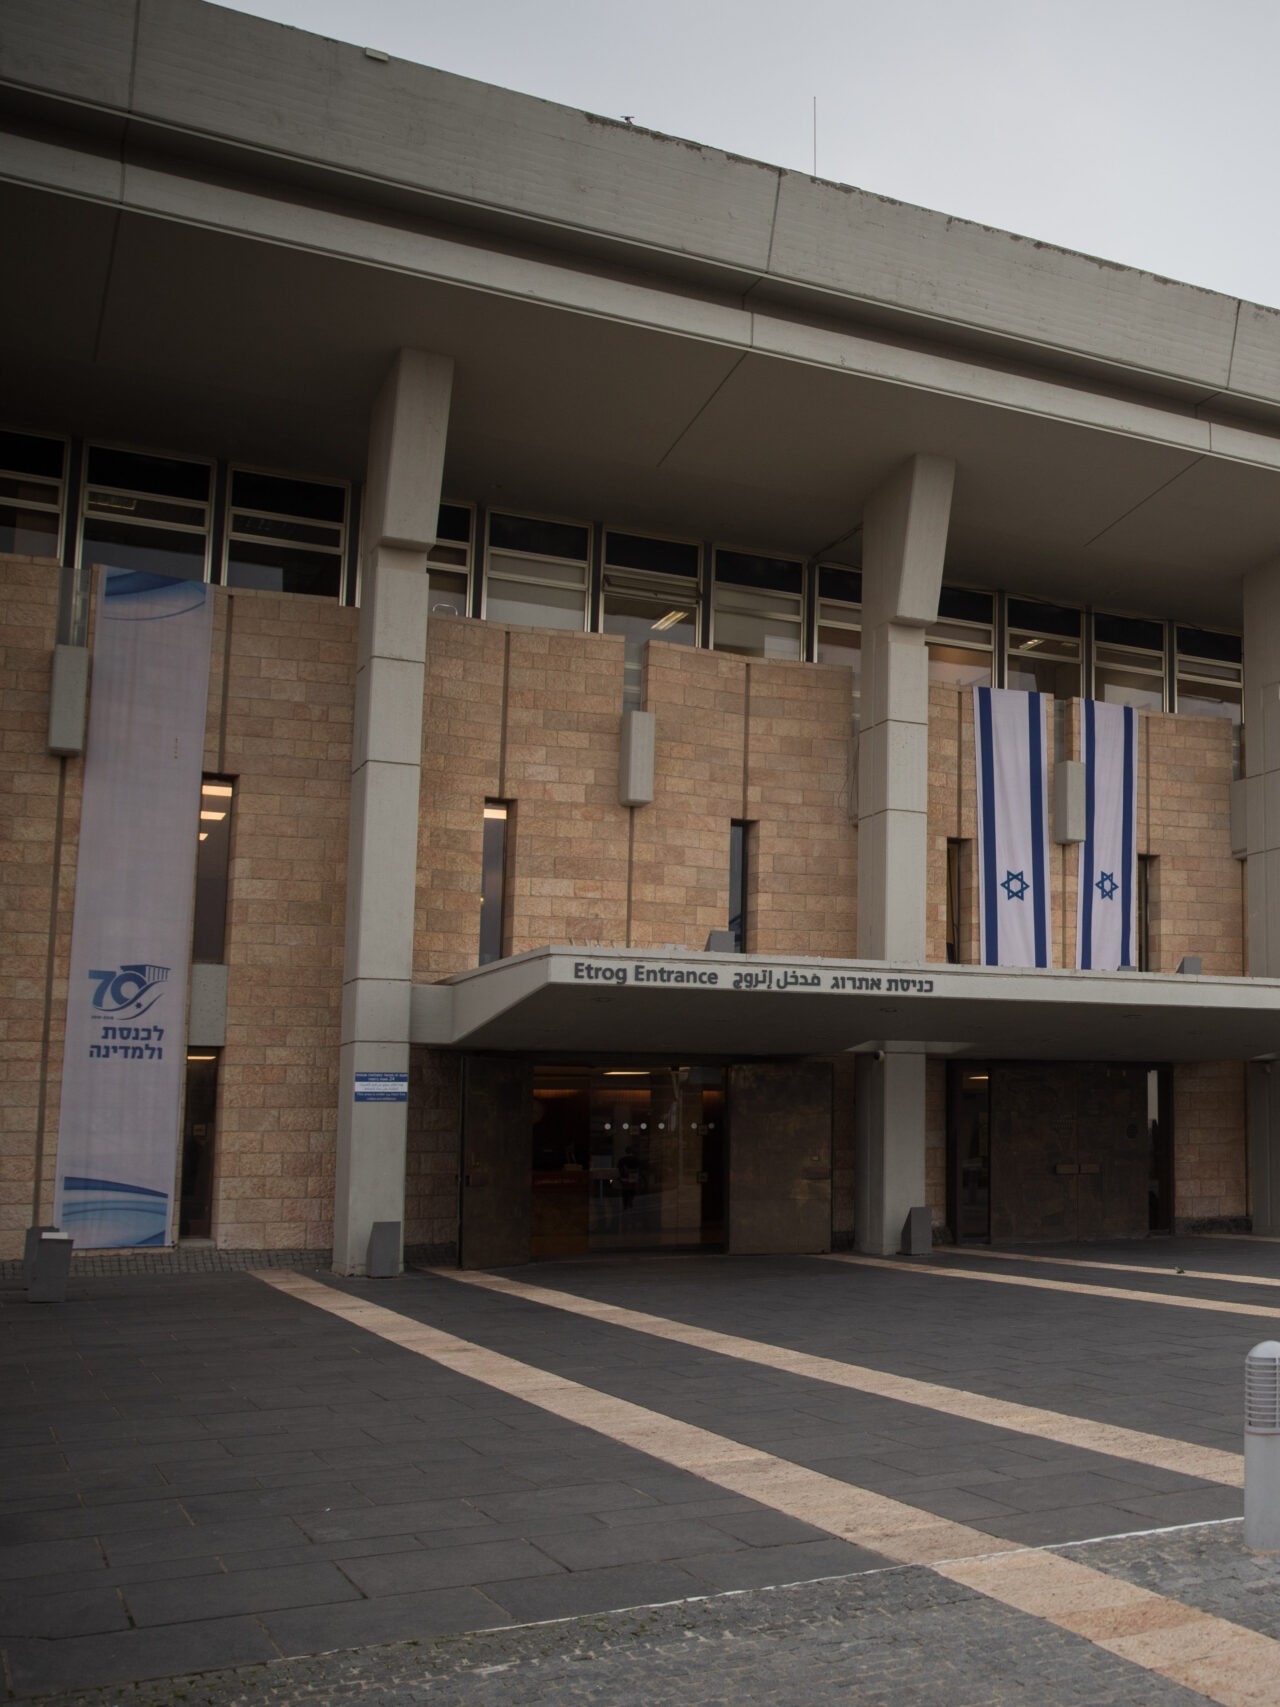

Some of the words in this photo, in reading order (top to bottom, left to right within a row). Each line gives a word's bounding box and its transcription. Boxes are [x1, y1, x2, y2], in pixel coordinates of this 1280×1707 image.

[574, 962, 627, 985] Etrog
[634, 965, 719, 985] Entrance
[776, 970, 821, 989] مدخل
[88, 969, 148, 1009] 70
[830, 976, 882, 990] אתרוג
[886, 978, 934, 993] כניסת
[101, 1025, 164, 1041] לכנסת
[89, 1044, 163, 1060] ולמדינה
